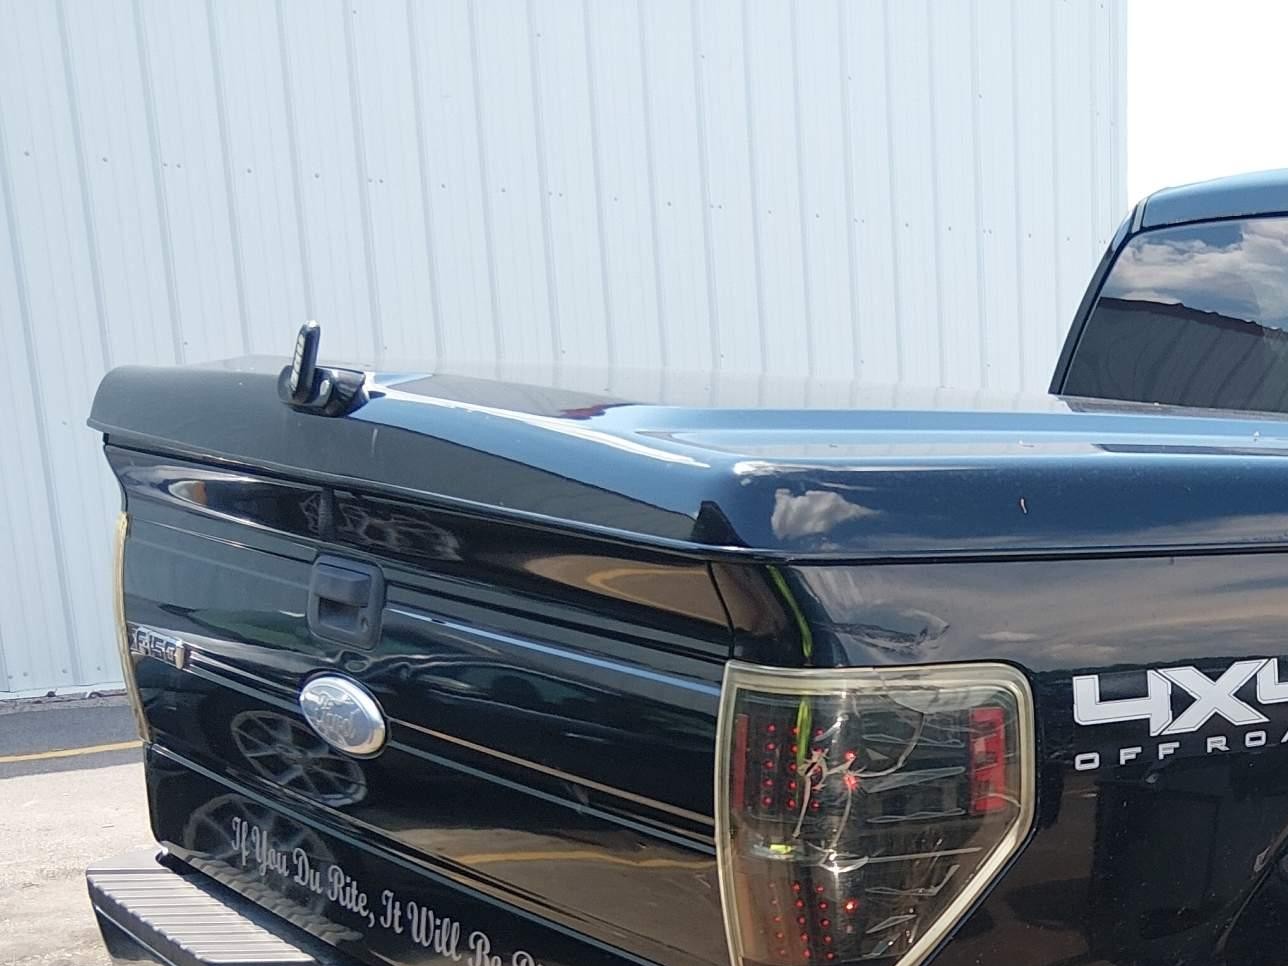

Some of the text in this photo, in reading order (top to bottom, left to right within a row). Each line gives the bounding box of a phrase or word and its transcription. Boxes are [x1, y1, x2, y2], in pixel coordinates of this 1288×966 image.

[1074, 742, 1181, 771] OFF
[231, 817, 249, 866] If
[251, 826, 289, 876] You
[327, 865, 375, 927] Rite,
[380, 889, 404, 934] It
[406, 901, 462, 962] Will
